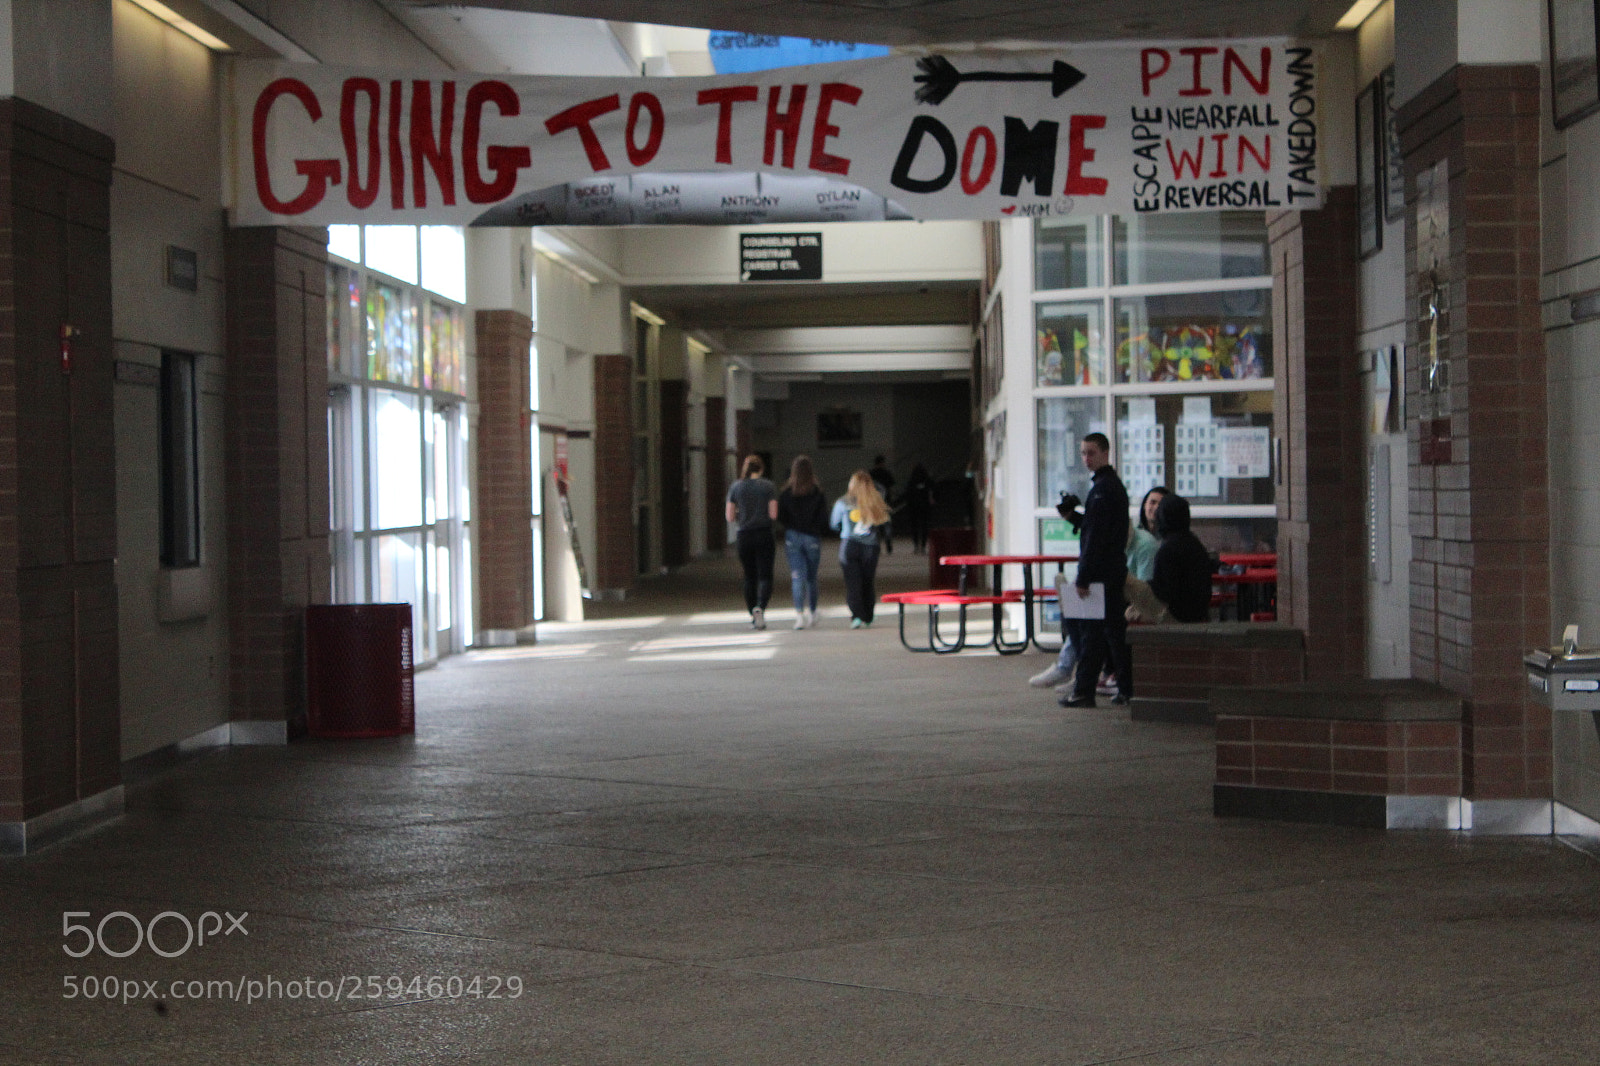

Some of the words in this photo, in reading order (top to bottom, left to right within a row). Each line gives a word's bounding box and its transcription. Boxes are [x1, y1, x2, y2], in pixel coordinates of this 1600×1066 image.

[1140, 47, 1271, 97] PIN
[1167, 103, 1279, 130] NEARFALL
[1285, 47, 1317, 205] TAKEDOWN
[252, 77, 531, 215] GOING
[545, 91, 665, 172] TO
[698, 82, 863, 176] THE
[890, 115, 1108, 197] DOME
[1131, 106, 1162, 212] ESCAPE
[1165, 134, 1271, 181] WIN
[644, 185, 680, 199] ALAN
[720, 196, 780, 208] ANTHONY
[816, 190, 861, 204] DYLAN
[1165, 180, 1281, 209] REVERSAL
